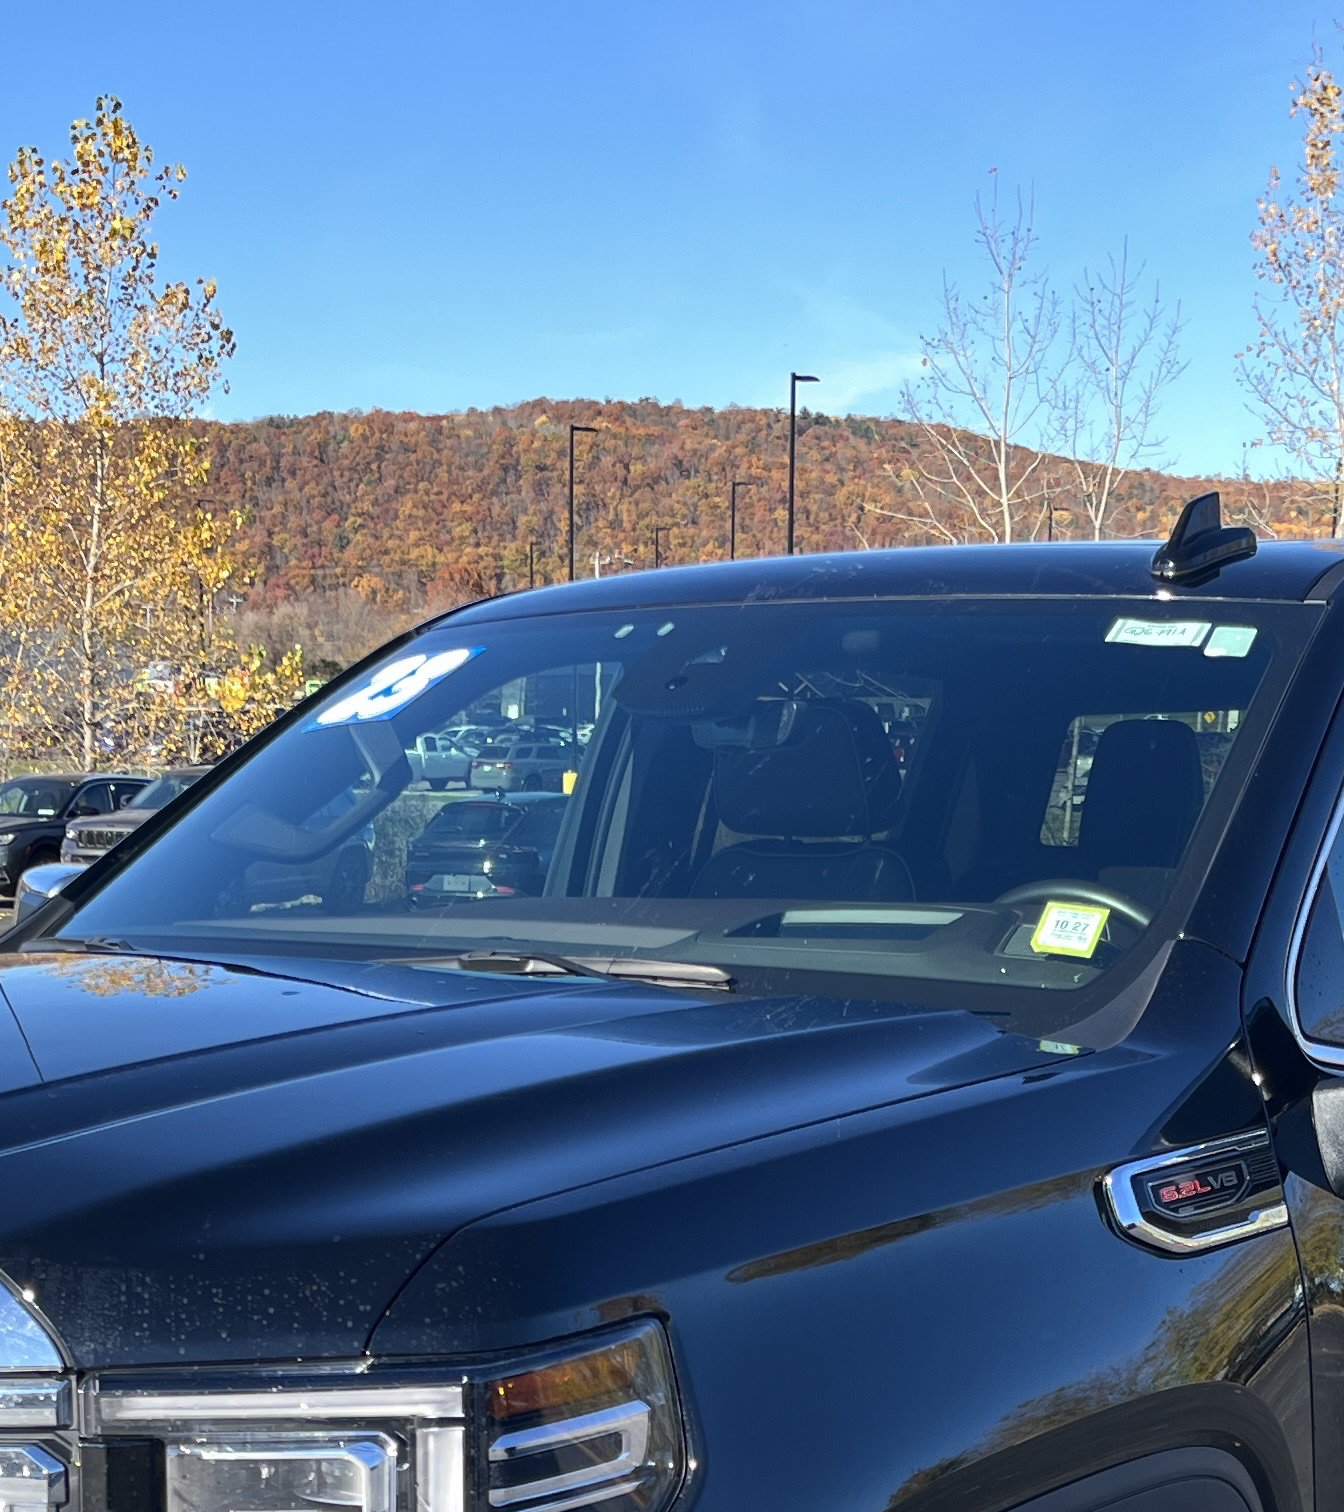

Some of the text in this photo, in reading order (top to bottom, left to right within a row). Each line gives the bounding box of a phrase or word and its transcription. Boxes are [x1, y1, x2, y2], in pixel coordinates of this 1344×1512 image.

[1054, 919, 1091, 932] 10 27
[1206, 1170, 1239, 1190] V8
